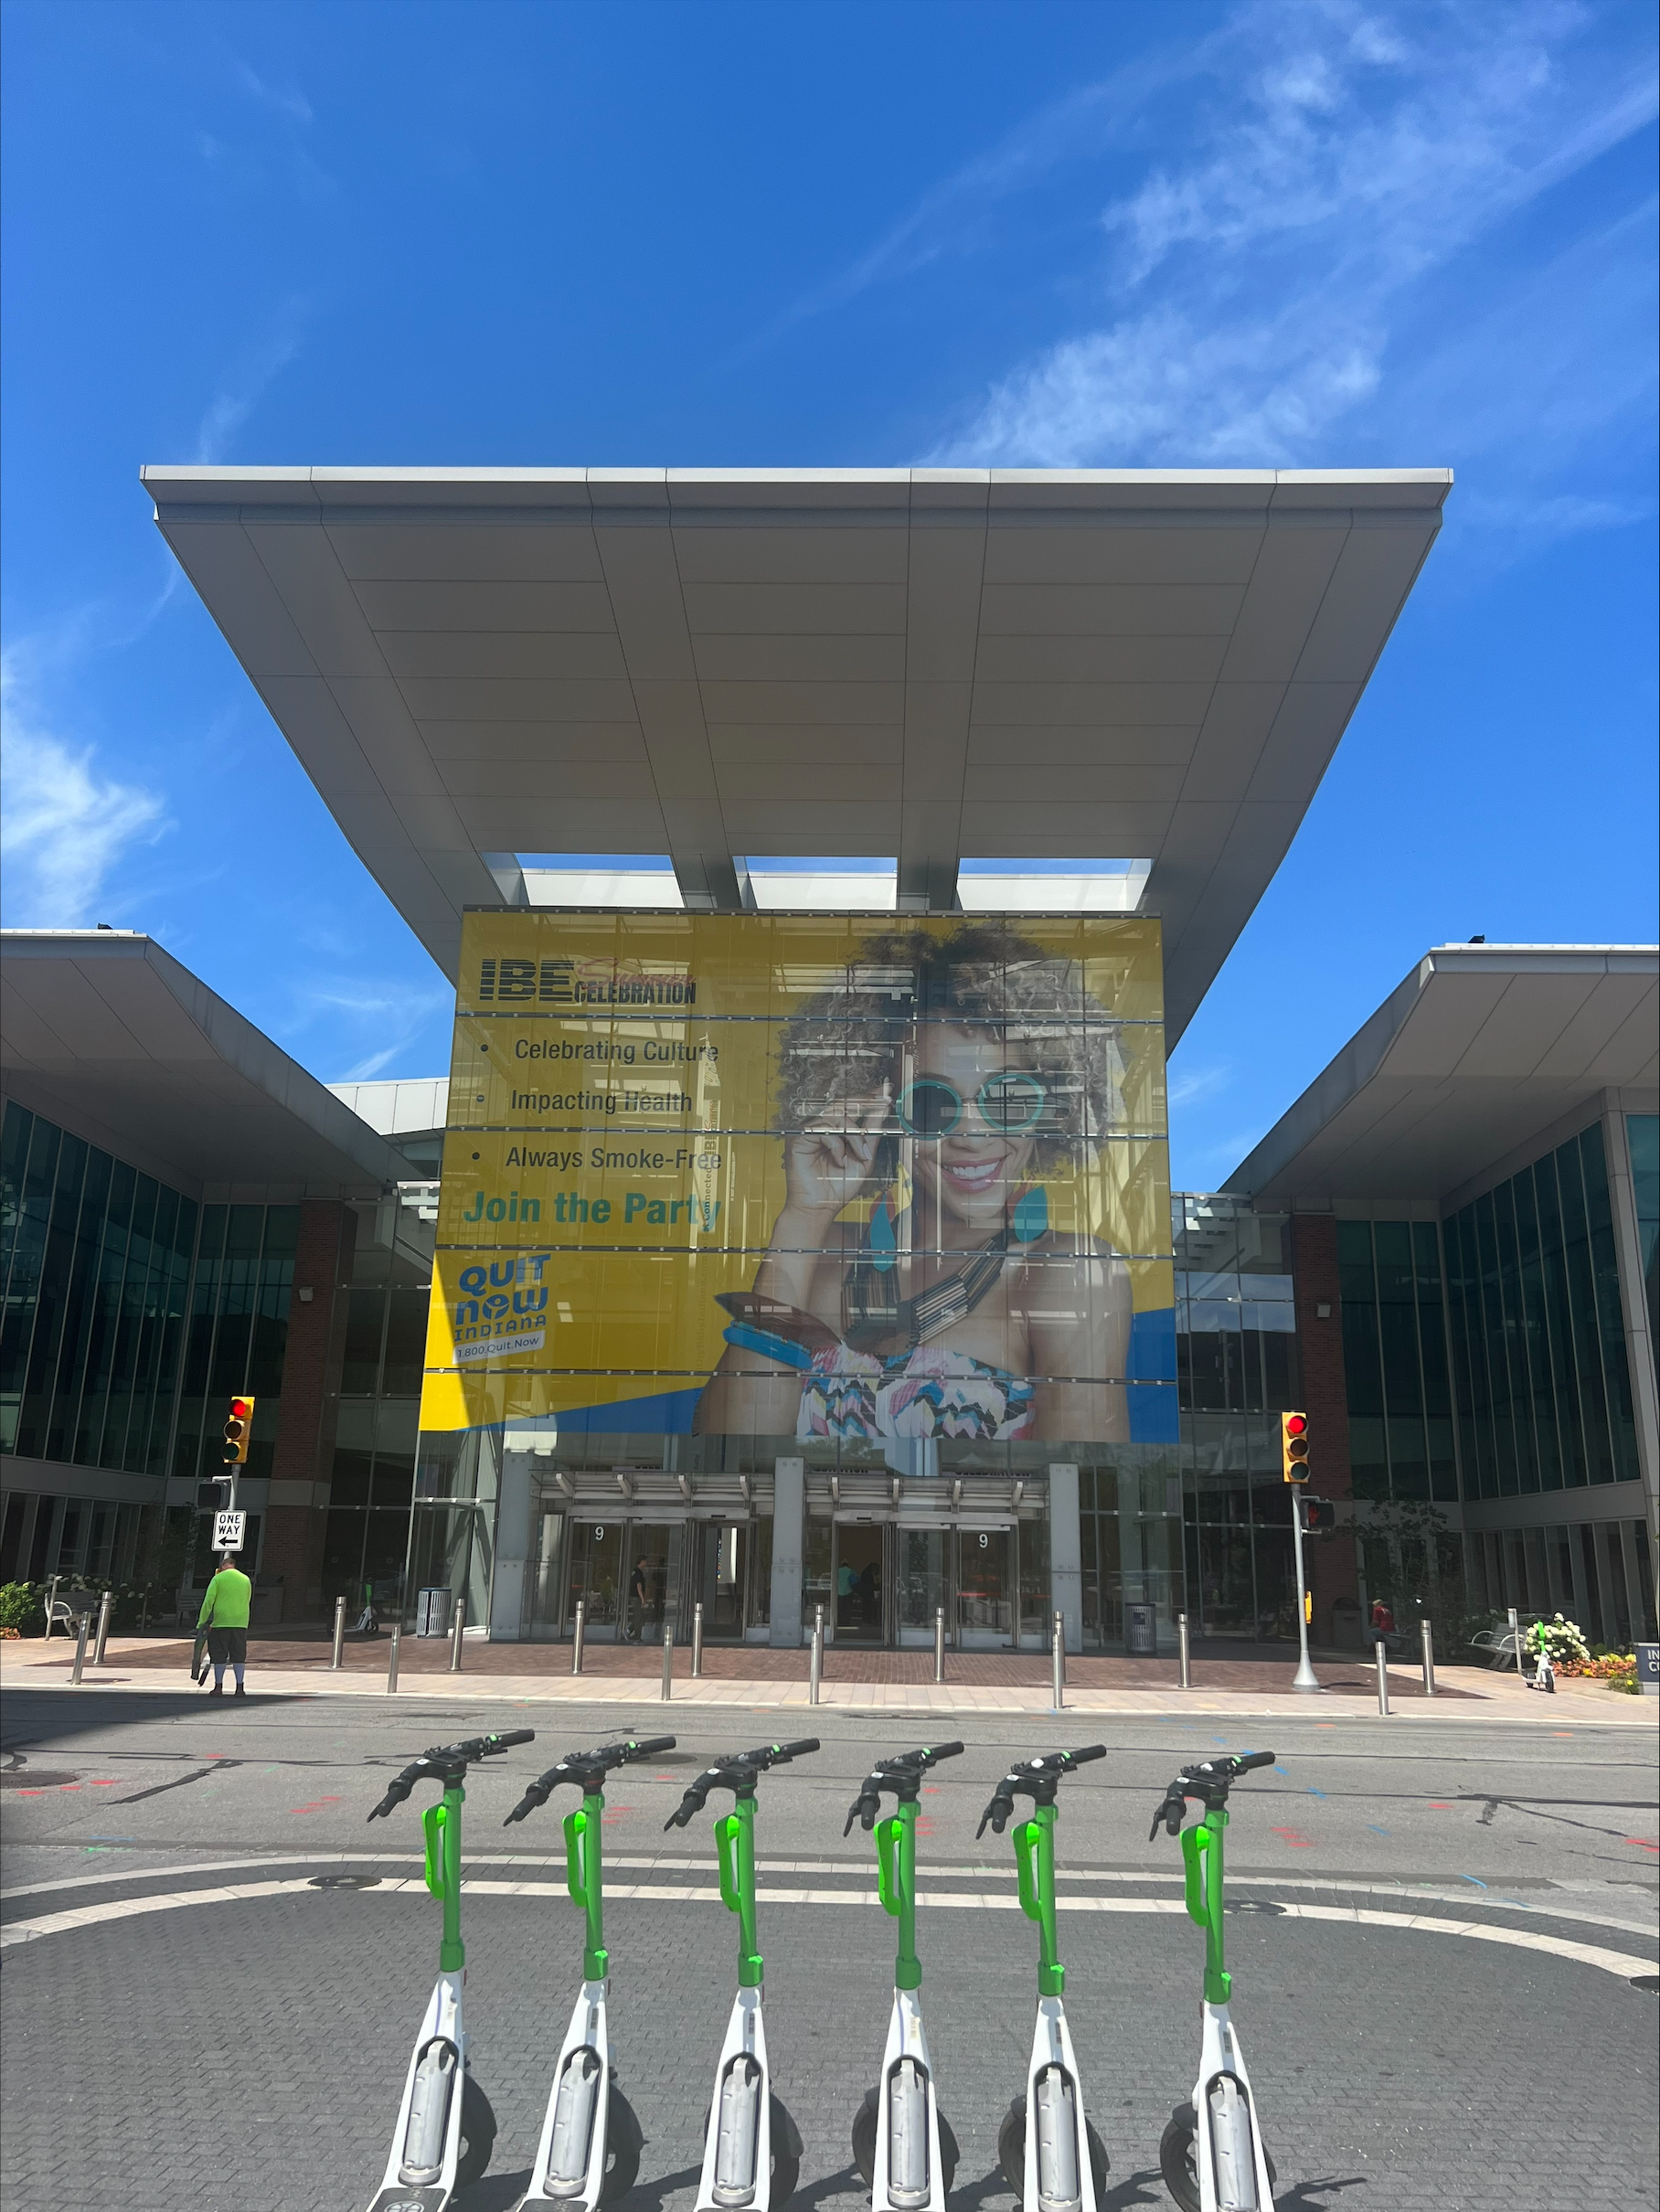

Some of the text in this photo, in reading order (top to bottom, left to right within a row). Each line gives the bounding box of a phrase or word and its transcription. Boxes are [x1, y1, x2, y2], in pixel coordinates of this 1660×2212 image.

[479, 958, 574, 1002] IBE
[578, 957, 697, 989] Summer
[574, 980, 696, 1005] CELEBRATION
[515, 1039, 719, 1064] Celebrating Culture
[511, 1090, 693, 1114] Impacting Health
[505, 1146, 722, 1171] Always Smoke-Free
[702, 1167, 712, 1221] Connected
[463, 1190, 722, 1233] Join the Party
[459, 1253, 551, 1297] QUIT
[457, 1336, 539, 1358] 1.800.Quit.Now
[218, 1525, 240, 1535] WAY
[219, 1514, 241, 1524] ONE
[595, 1526, 604, 1540] 9
[979, 1533, 988, 1548] 9
[1648, 1661, 1659, 1672] C
